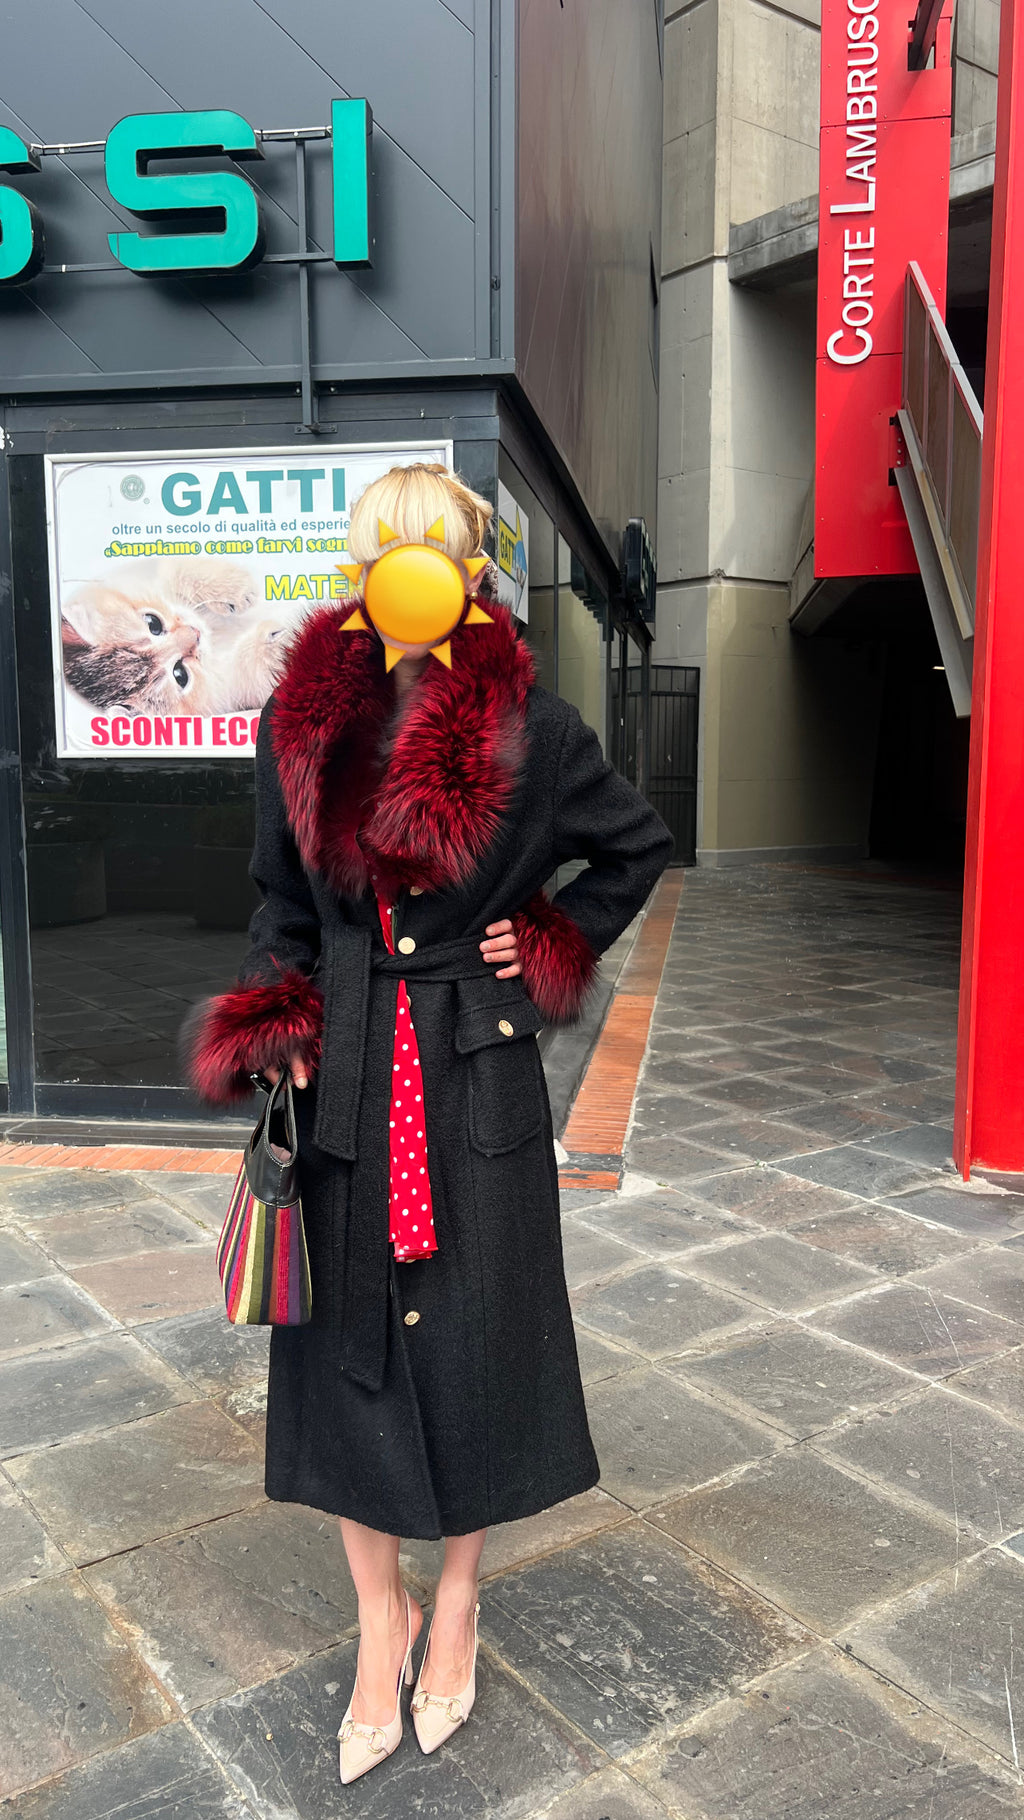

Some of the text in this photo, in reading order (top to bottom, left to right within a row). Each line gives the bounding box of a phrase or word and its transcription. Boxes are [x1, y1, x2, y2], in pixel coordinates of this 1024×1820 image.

[0, 97, 371, 281] SI
[826, 227, 876, 365] CORTE
[161, 468, 346, 516] GATTI
[112, 523, 141, 535] oltre
[146, 524, 162, 534] un
[166, 521, 211, 534] secolo
[215, 520, 227, 532] di
[231, 519, 276, 535] qualità
[280, 518, 297, 531] ed
[205, 540, 253, 554] come
[256, 536, 303, 553] farvi
[90, 716, 203, 746] SCONTI
